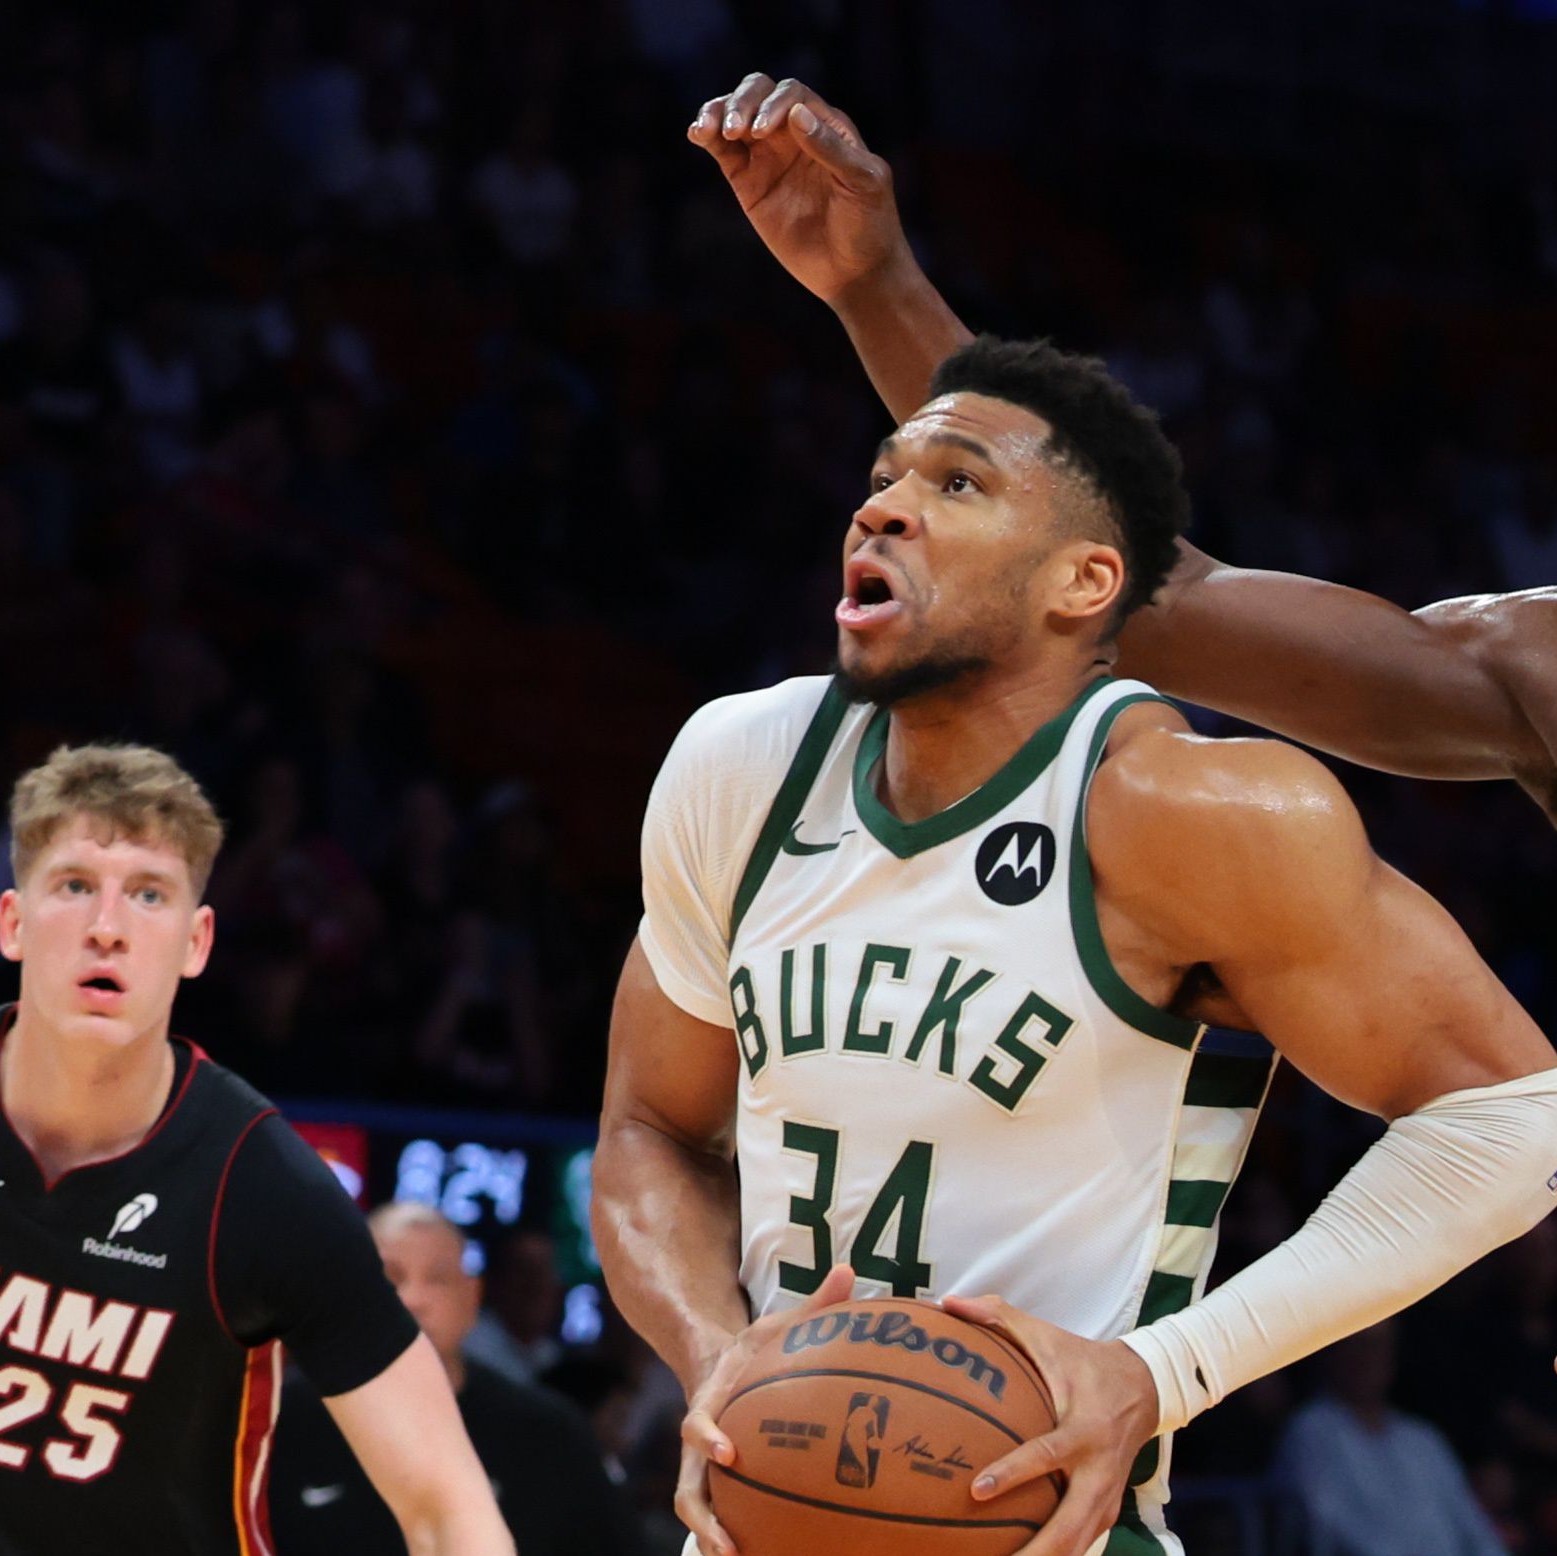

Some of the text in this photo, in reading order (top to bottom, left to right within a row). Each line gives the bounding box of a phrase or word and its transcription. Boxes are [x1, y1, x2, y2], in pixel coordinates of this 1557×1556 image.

[730, 940, 1080, 1118] BUCKS
[82, 1237, 168, 1269] Robinhood
[776, 1116, 940, 1299] 34
[782, 1310, 1009, 1404] Wilson
